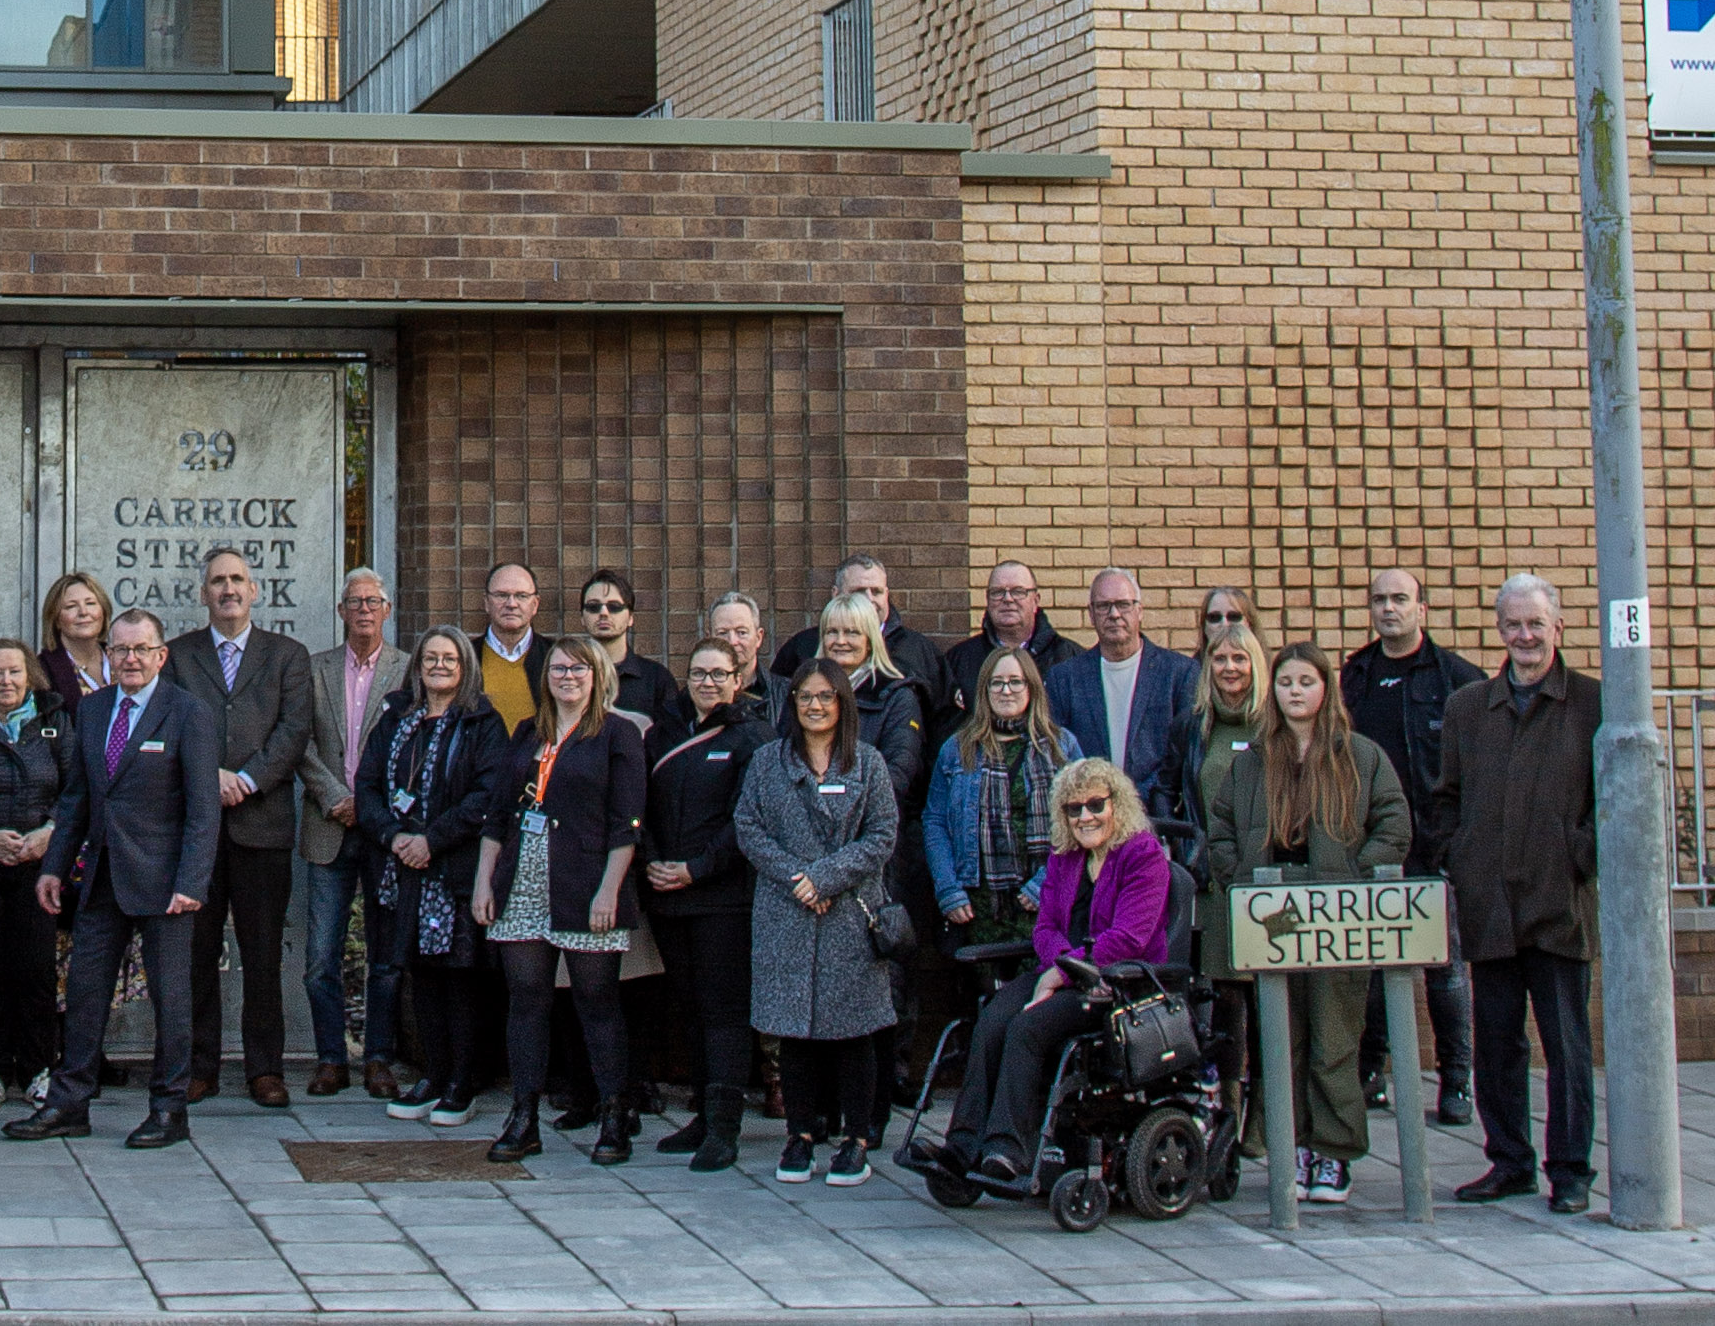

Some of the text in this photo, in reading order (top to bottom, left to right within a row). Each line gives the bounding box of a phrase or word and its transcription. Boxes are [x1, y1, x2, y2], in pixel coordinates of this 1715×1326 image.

[178, 429, 236, 471] 29
[114, 497, 297, 528] CARRICK
[113, 577, 297, 608] CARCK
[1627, 605, 1638, 622] R
[1628, 625, 1639, 642] 6
[1248, 886, 1430, 924] CARRICK
[1267, 926, 1413, 964] STREET
